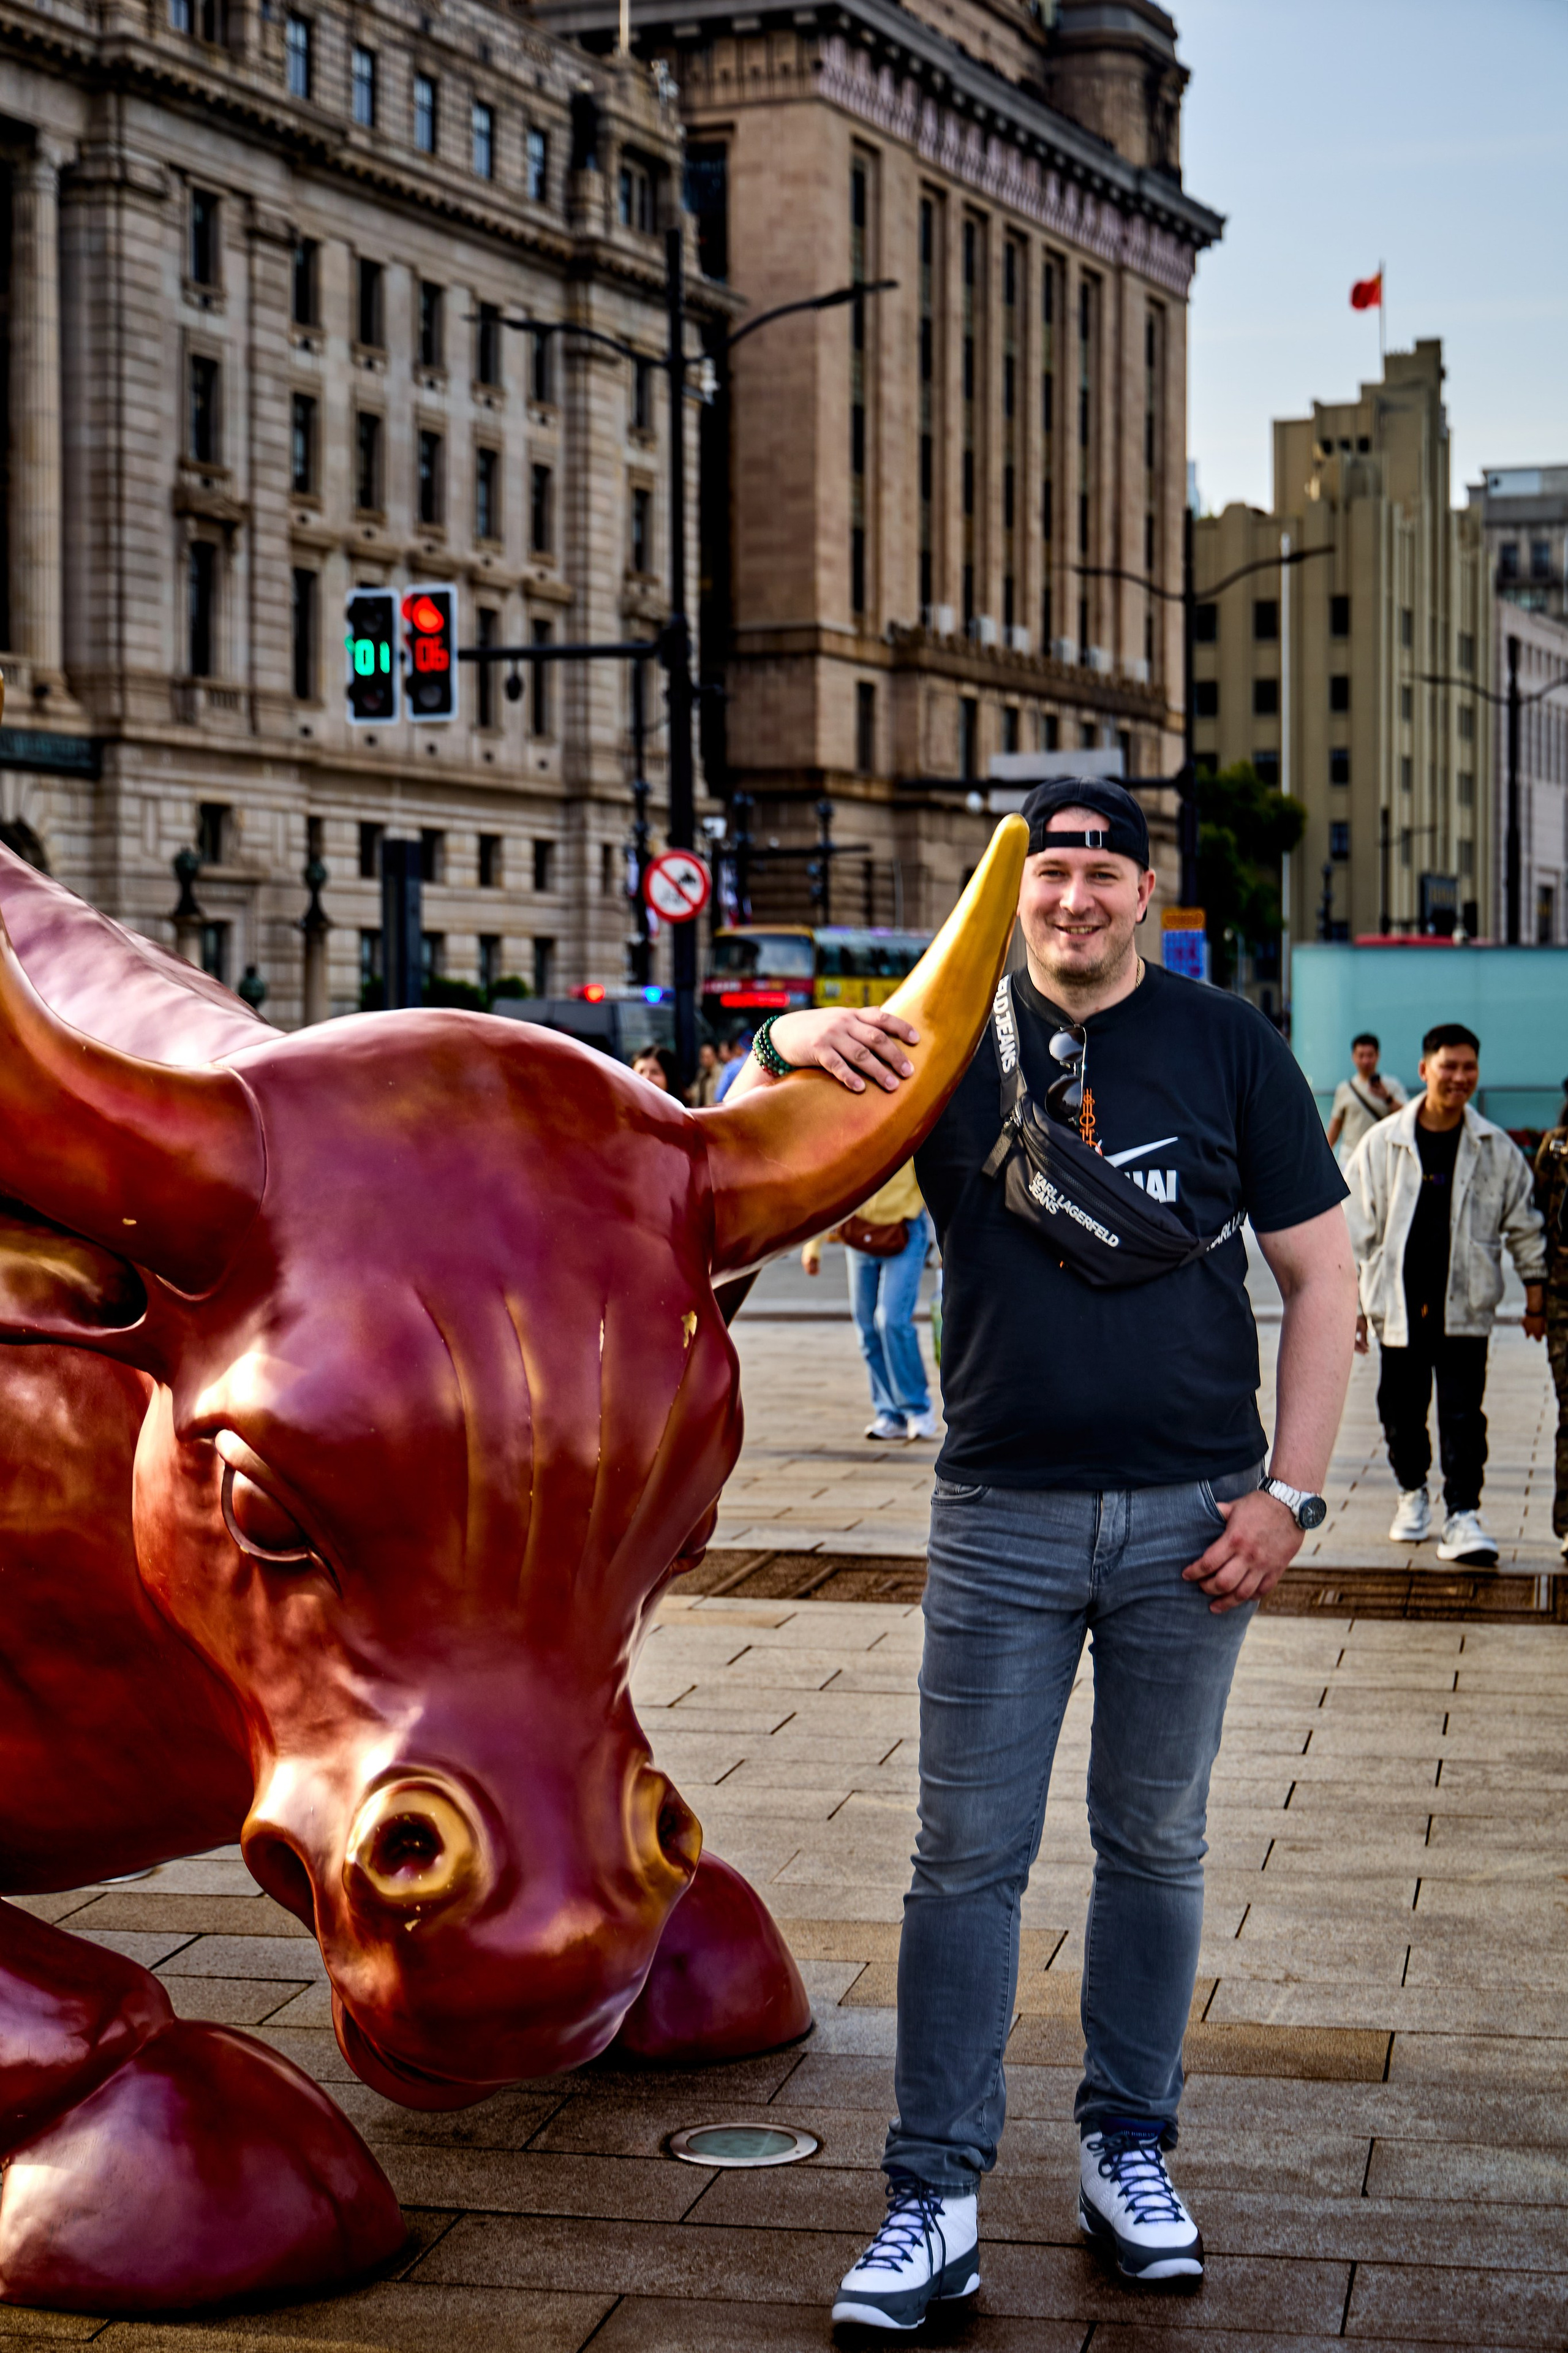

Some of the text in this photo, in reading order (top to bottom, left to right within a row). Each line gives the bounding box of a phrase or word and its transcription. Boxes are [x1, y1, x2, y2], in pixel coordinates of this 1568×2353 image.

[355, 639, 390, 676] 01
[995, 1011, 1016, 1073] JEANS
[1028, 1179, 1060, 1215] JEANS
[1033, 1171, 1119, 1247] KARL LAGERFELD
